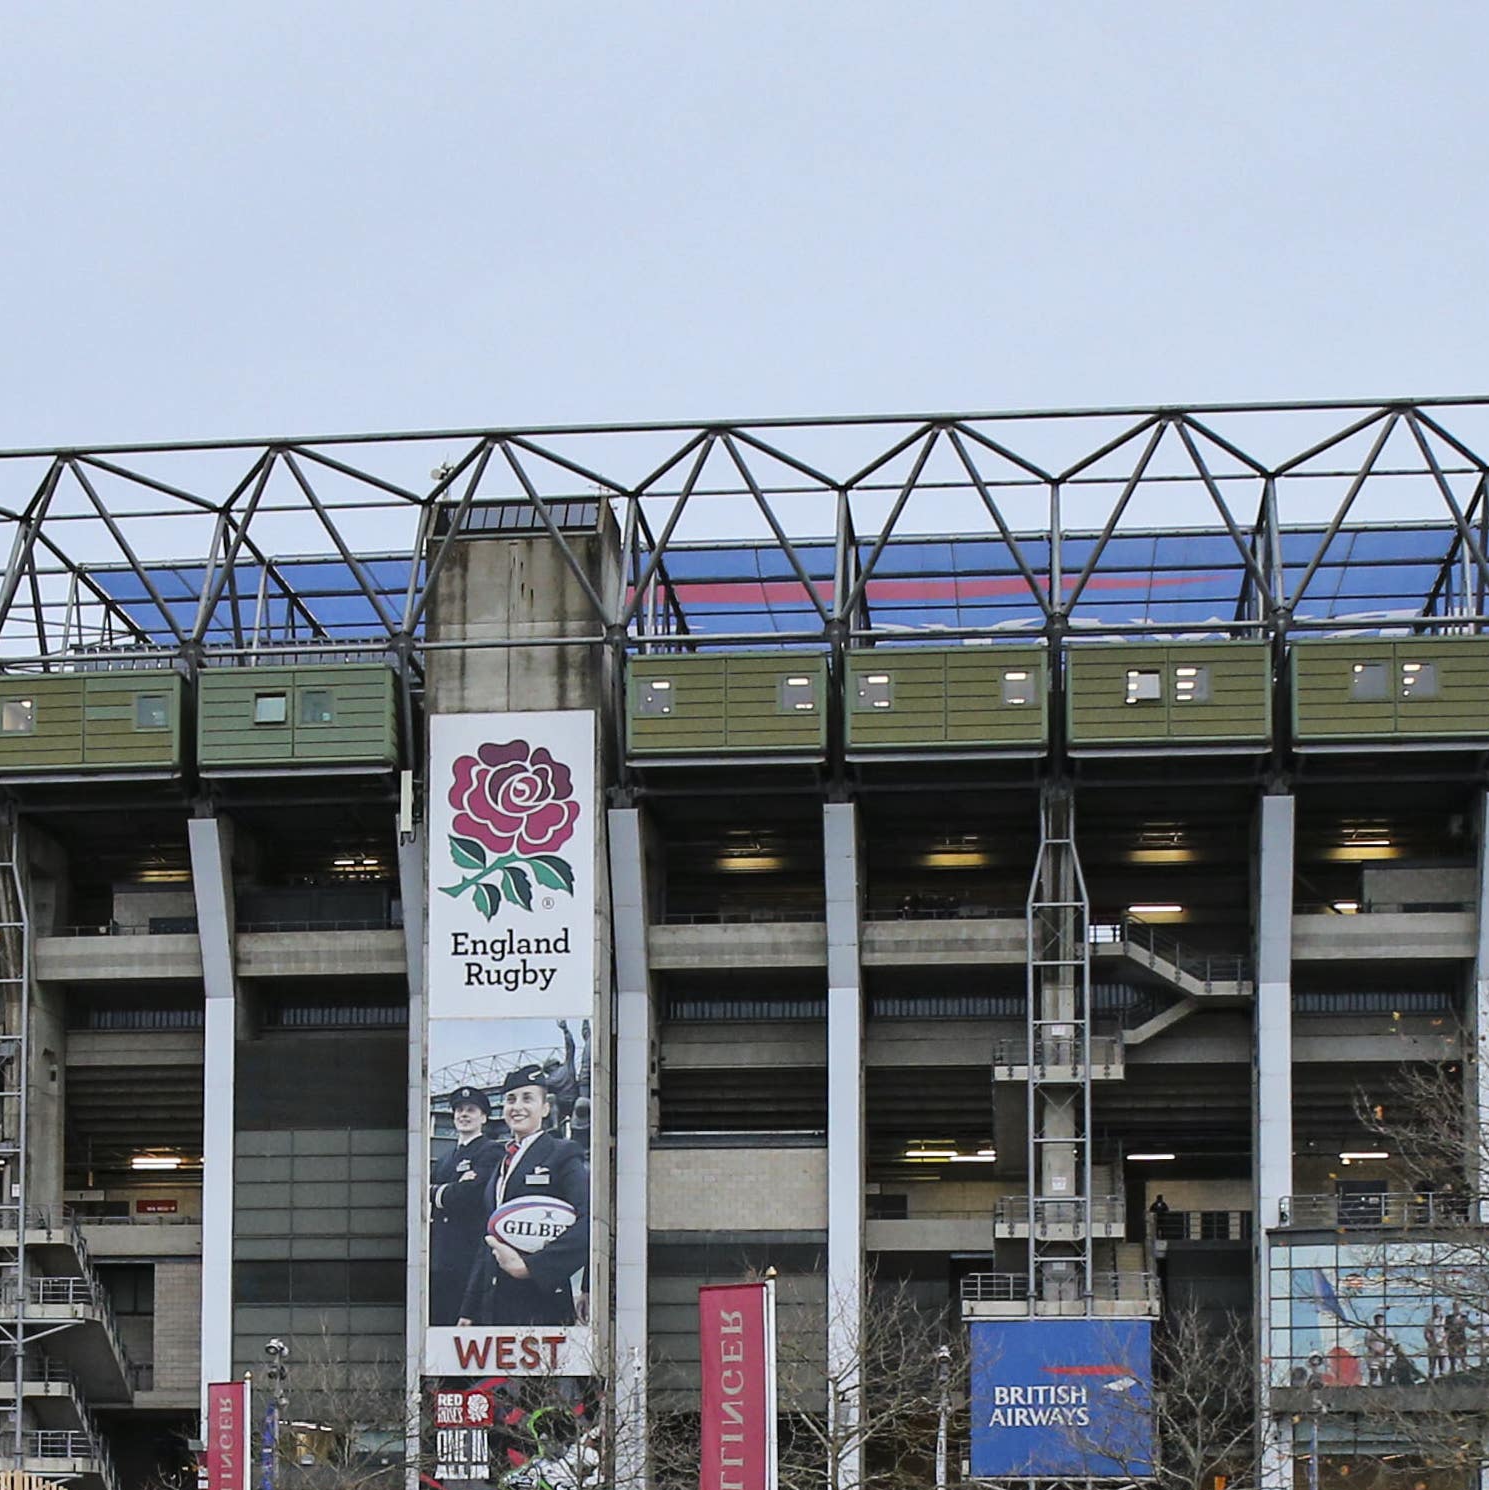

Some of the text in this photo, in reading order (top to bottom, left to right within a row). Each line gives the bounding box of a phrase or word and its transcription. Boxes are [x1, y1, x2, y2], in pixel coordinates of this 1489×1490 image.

[451, 928, 570, 961] England
[465, 959, 557, 991] Rugby
[453, 1336, 566, 1369] WEST
[438, 1393, 462, 1406] RED
[995, 1385, 1087, 1405] BRITISH
[989, 1407, 1090, 1427] AIRWAYS
